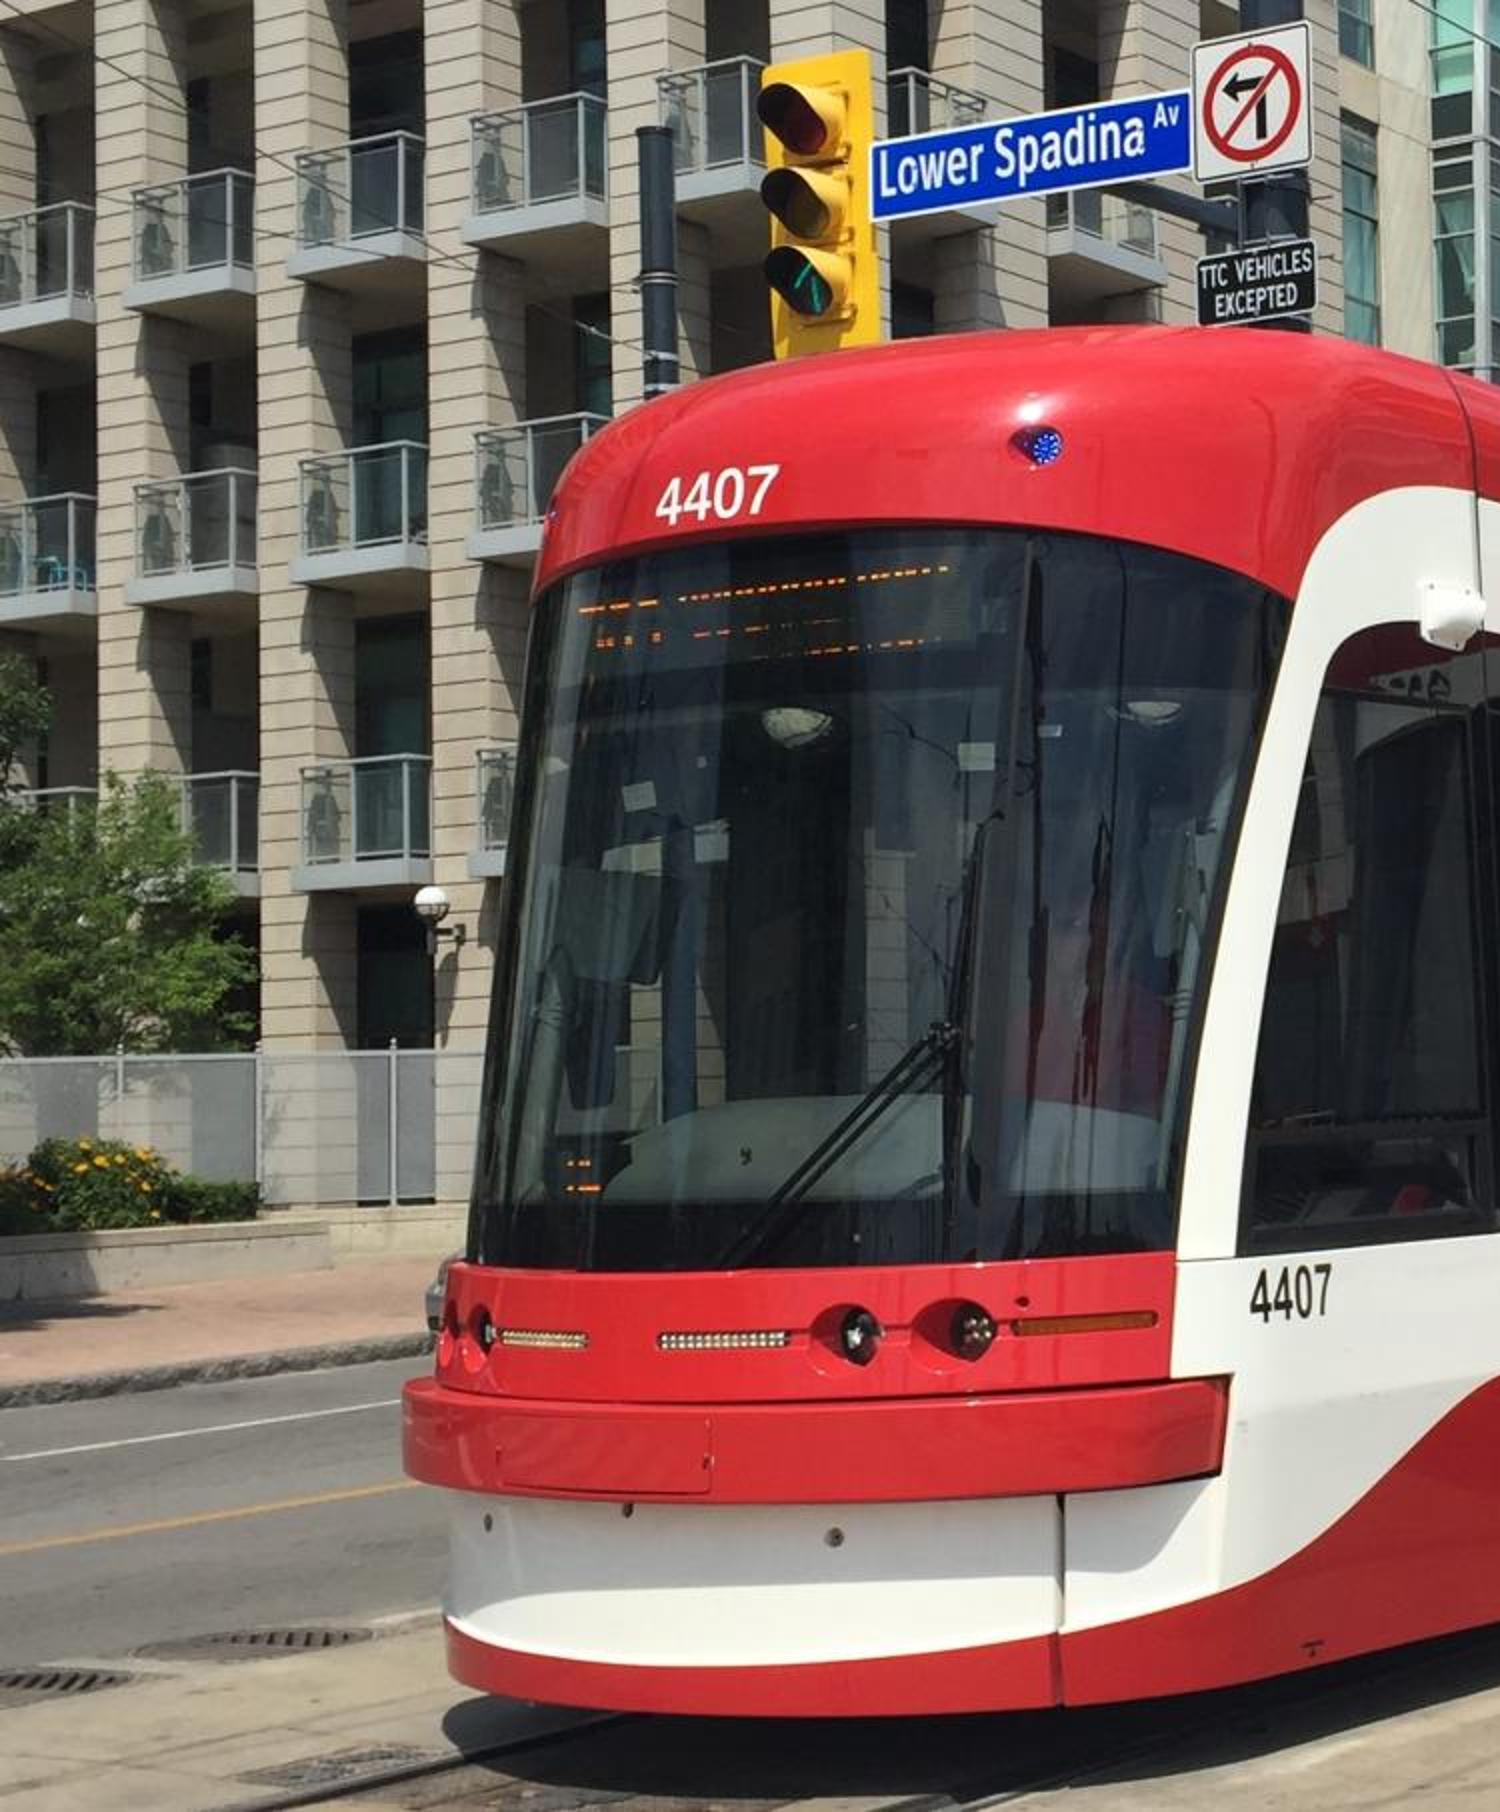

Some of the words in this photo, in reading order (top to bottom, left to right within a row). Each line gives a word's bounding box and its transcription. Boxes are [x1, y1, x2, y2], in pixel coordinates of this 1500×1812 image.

[880, 143, 985, 198] Lower
[994, 112, 1146, 188] Spadina
[1153, 102, 1180, 128] Av
[1200, 263, 1228, 289] TTC
[1234, 248, 1312, 283] VEHICLES
[1215, 282, 1298, 318] EXCEPTED
[655, 463, 781, 526] 4407
[1250, 1263, 1332, 1323] 4407
